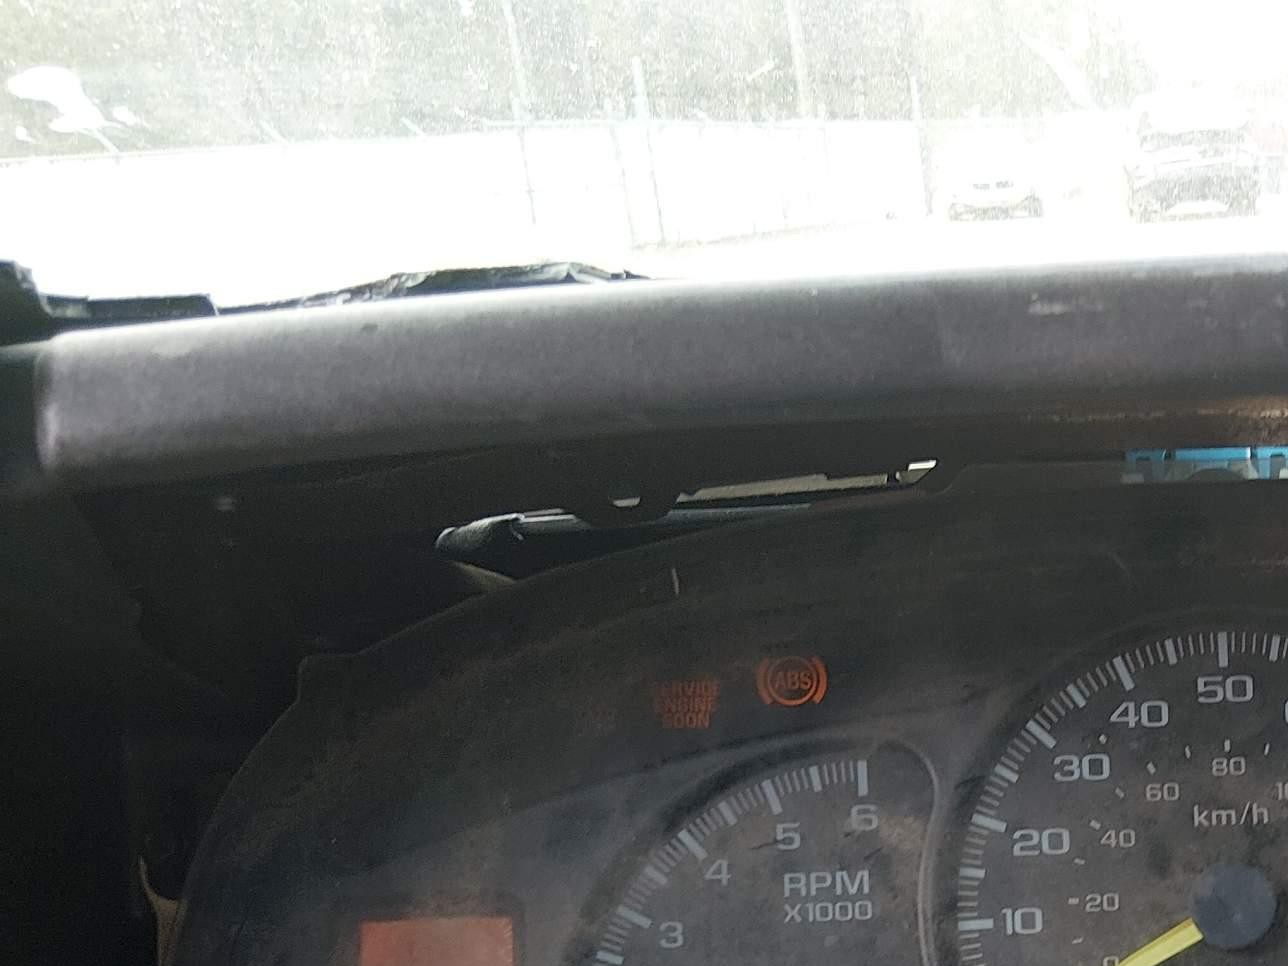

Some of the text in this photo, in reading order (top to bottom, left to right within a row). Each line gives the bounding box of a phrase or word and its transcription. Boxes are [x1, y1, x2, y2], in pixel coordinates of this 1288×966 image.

[773, 669, 813, 691] ABS
[1197, 674, 1254, 703] 50
[1109, 700, 1169, 729] 40
[1053, 753, 1110, 782] 30
[1211, 757, 1246, 777] 80
[1145, 781, 1180, 802] 60
[850, 804, 879, 832] 6
[1193, 803, 1270, 828] km/h
[775, 823, 801, 851] 5
[1012, 828, 1070, 856] 20
[1100, 828, 1136, 849] 40
[705, 860, 731, 886] 4
[783, 870, 870, 897] RPM
[783, 900, 872, 922] X1000
[1085, 892, 1121, 913] 20
[1002, 907, 1043, 935] 10
[659, 922, 684, 949] 3
